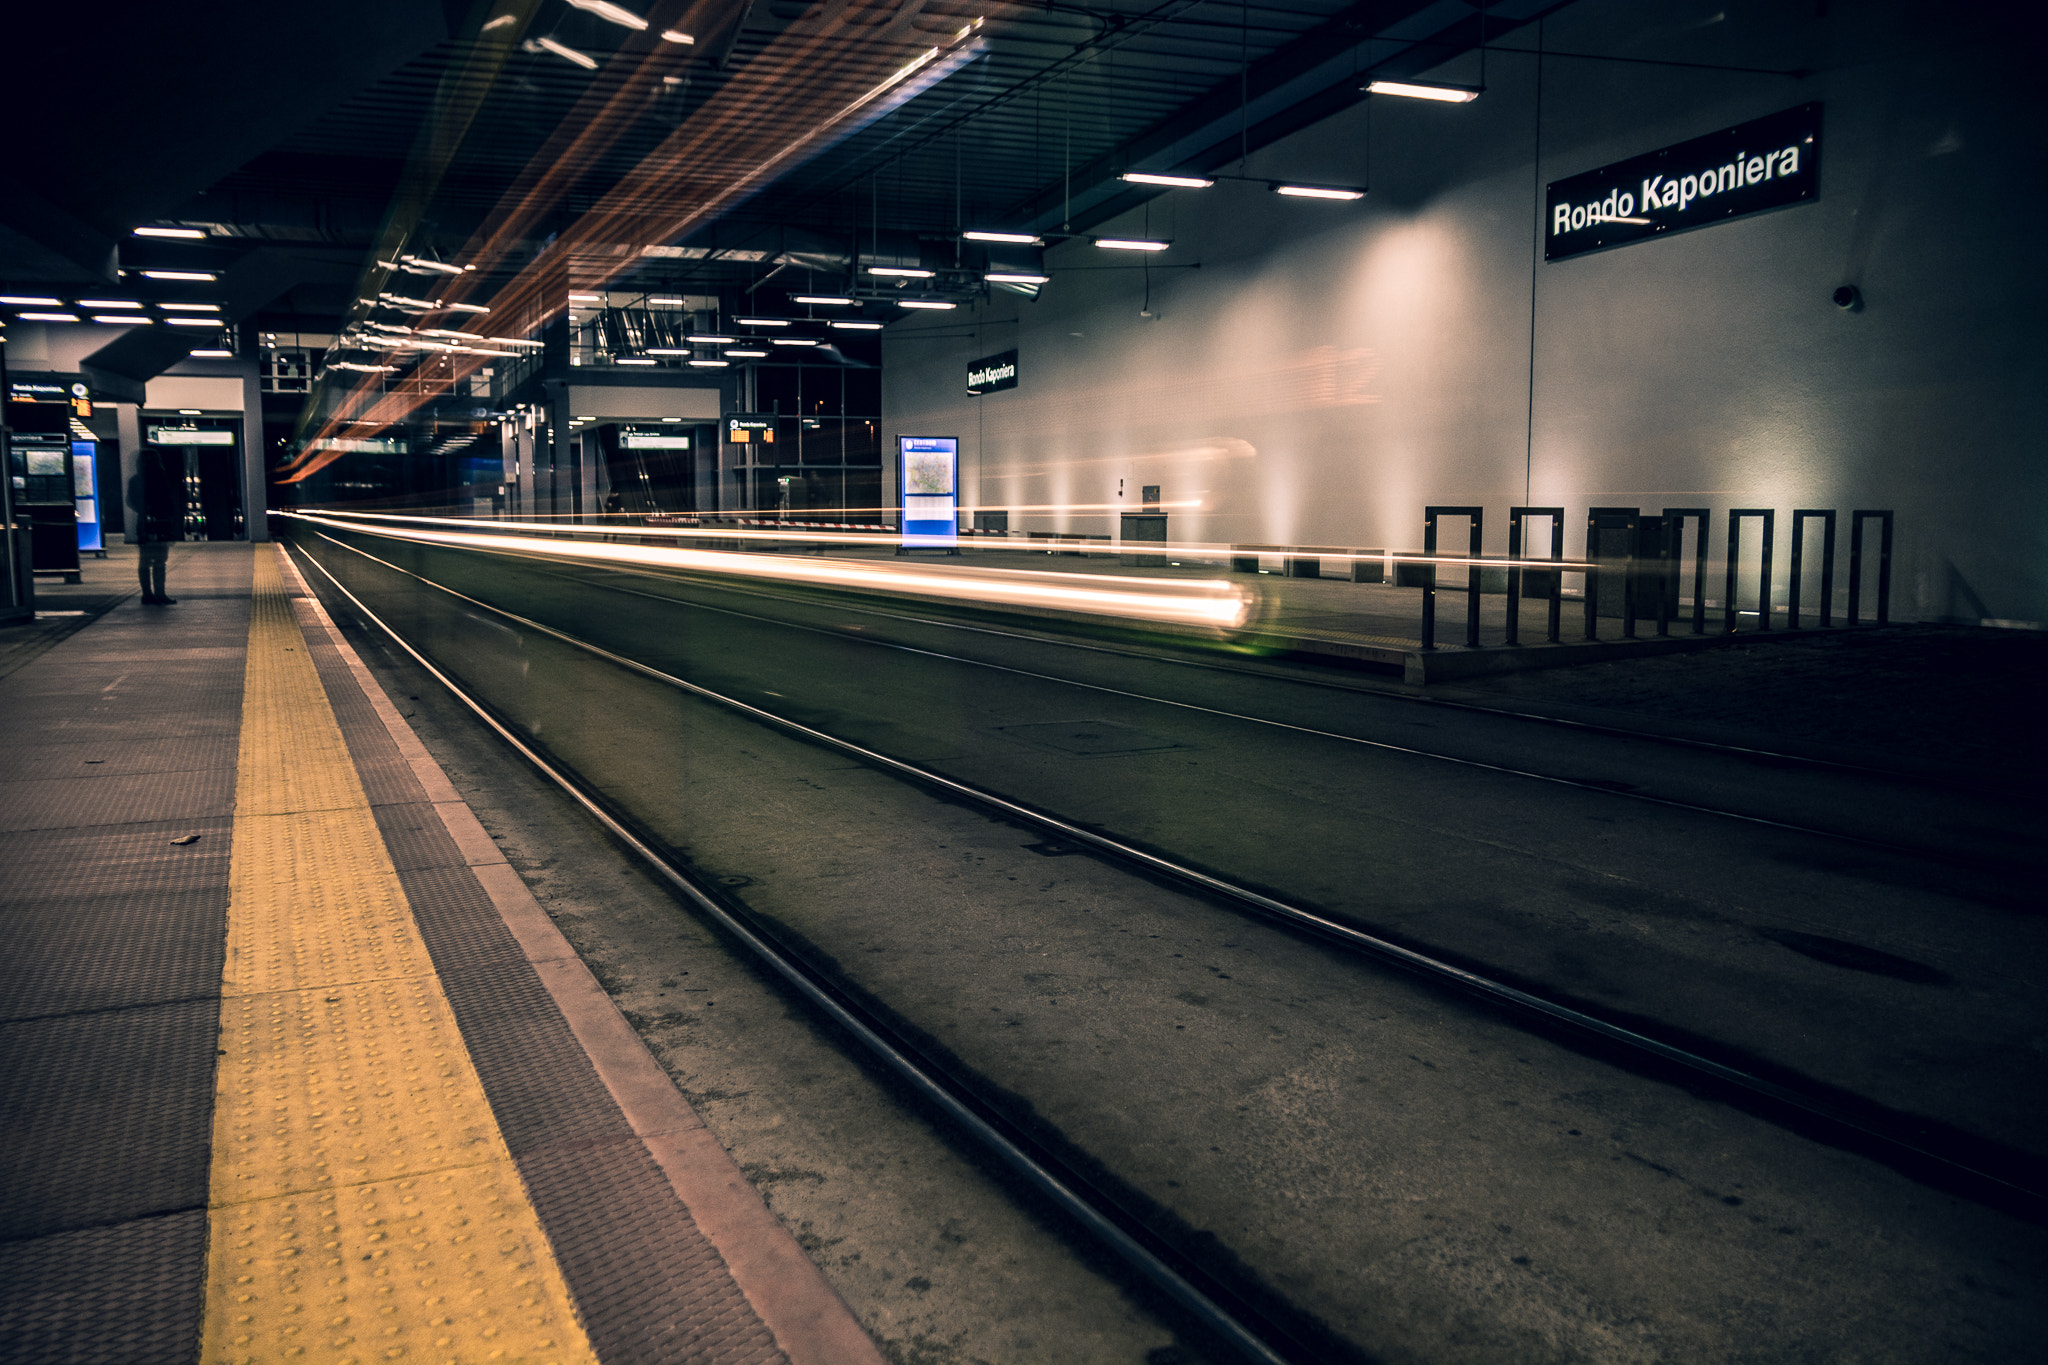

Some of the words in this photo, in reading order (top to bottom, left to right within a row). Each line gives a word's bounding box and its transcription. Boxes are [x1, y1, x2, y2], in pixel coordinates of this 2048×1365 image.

[1553, 188, 1634, 236] Rondo
[1641, 145, 1800, 212] Kaponiera
[968, 369, 985, 387] Rondo
[986, 363, 1014, 385] Kaponiera
